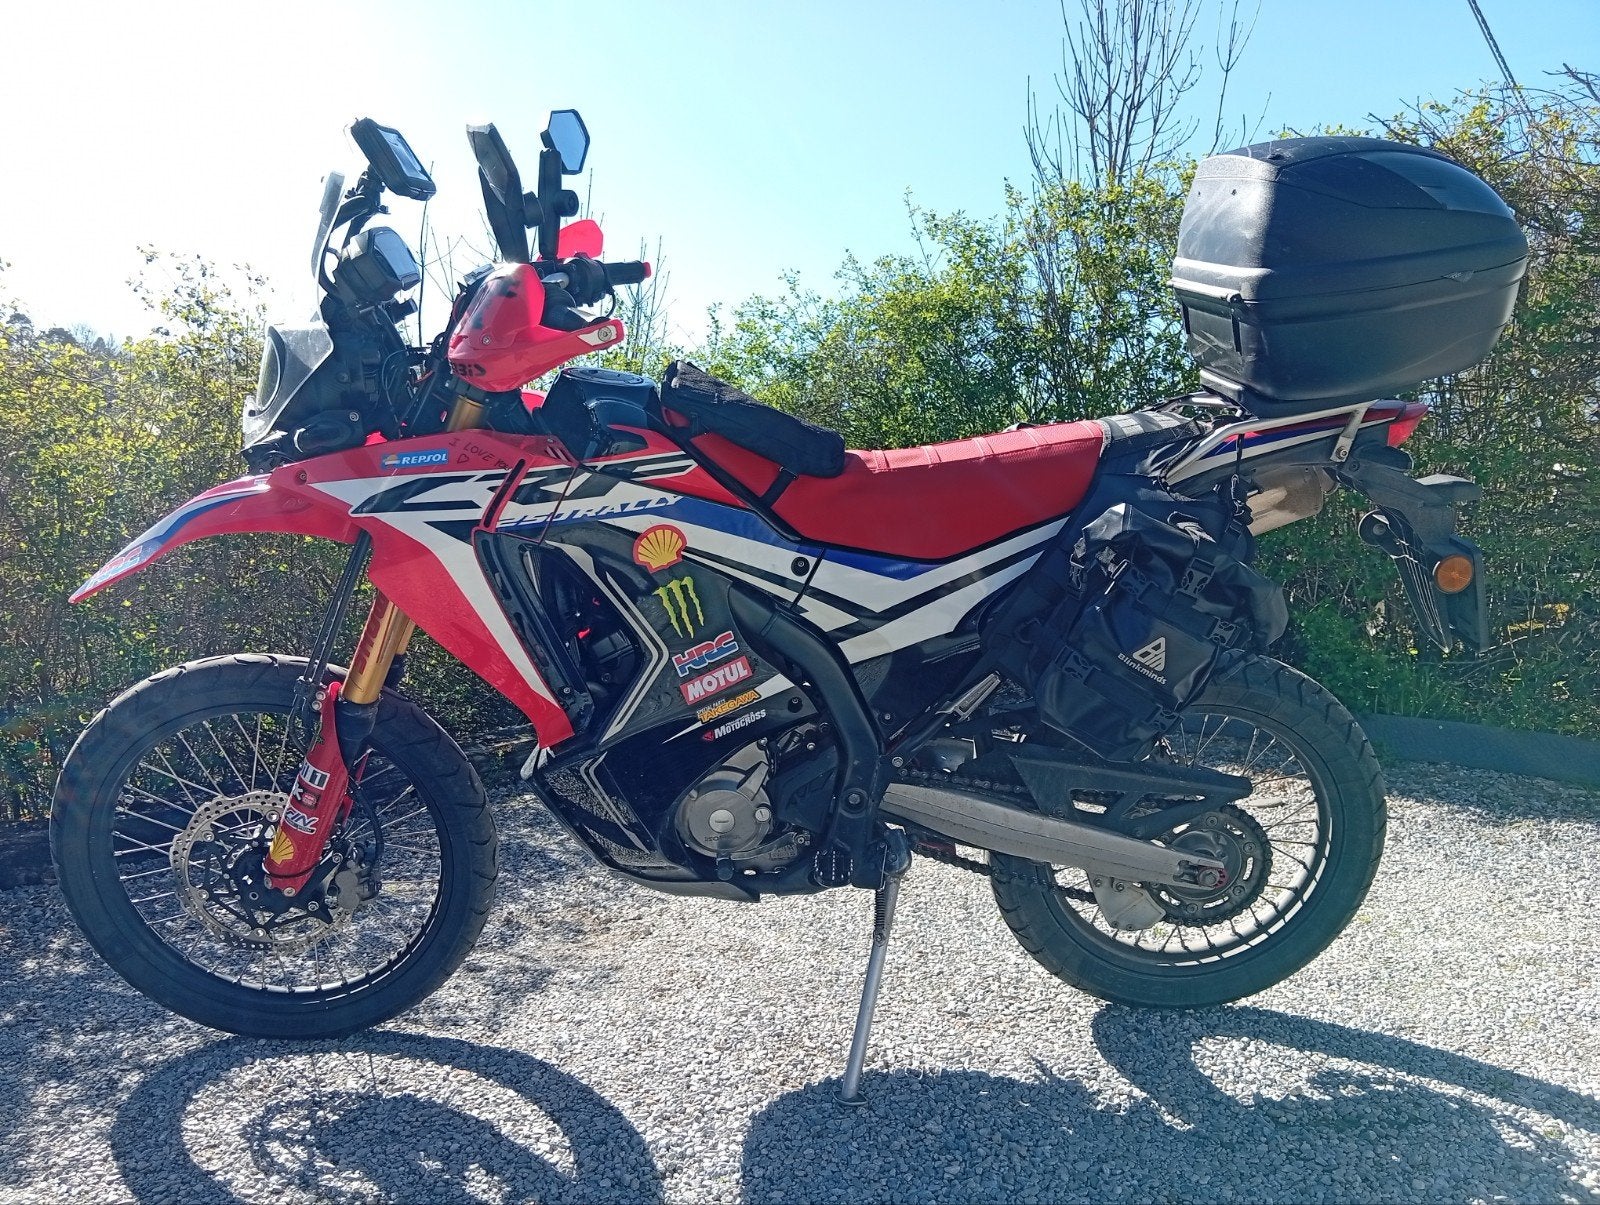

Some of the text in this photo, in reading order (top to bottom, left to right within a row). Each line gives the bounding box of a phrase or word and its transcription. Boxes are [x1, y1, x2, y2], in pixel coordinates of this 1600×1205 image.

[401, 453, 447, 465] REPSOL
[463, 442, 495, 462] LOVE
[672, 631, 739, 677] HRC
[1117, 652, 1167, 685] Blinkminds
[687, 661, 749, 701] MOTUL
[699, 690, 759, 722] TAKEGAWA
